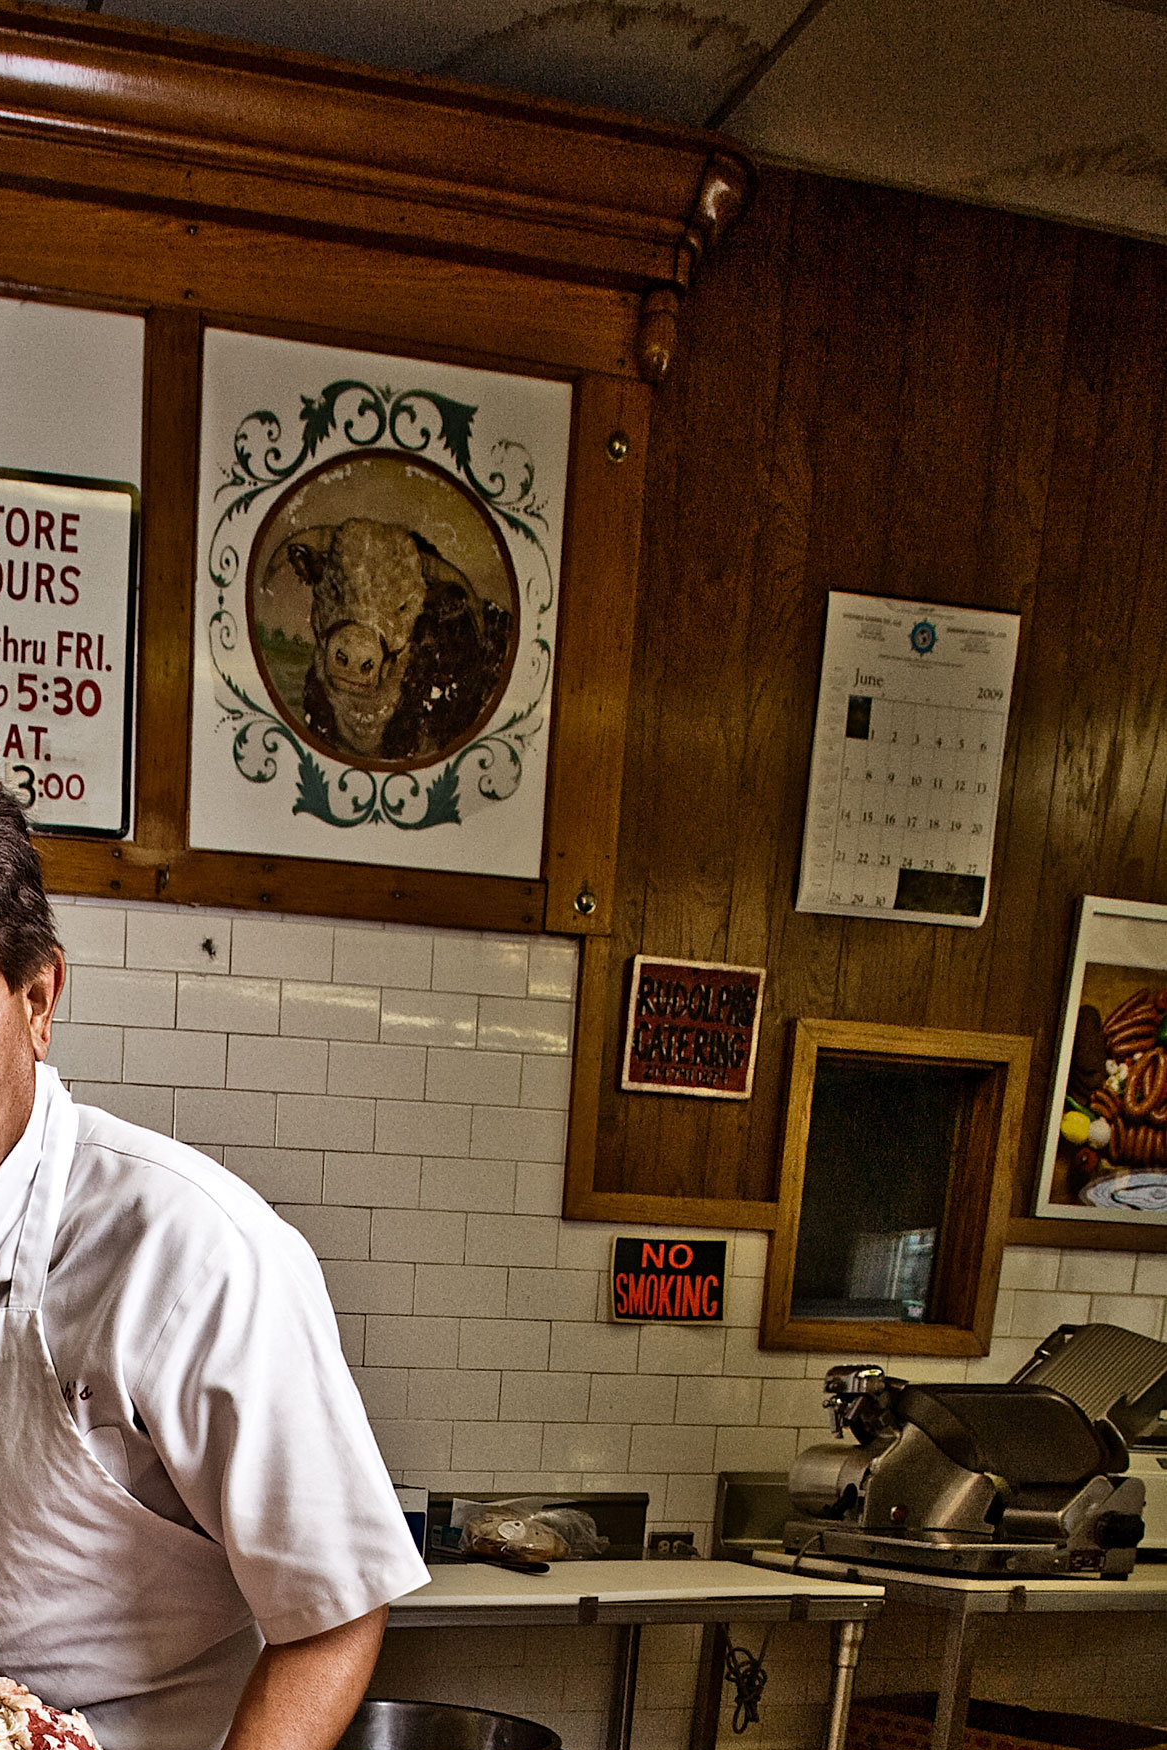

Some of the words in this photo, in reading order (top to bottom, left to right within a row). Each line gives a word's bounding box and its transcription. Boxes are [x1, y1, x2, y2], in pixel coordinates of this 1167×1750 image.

[56, 631, 113, 673] FRI.
[17, 673, 102, 718] 5:30
[853, 667, 884, 688] June
[977, 687, 1004, 701] 2009
[12, 764, 85, 810] 3:00
[634, 1020, 747, 1070] CATERING
[641, 1242, 694, 1269] NO
[615, 1272, 719, 1317] SMOKING
